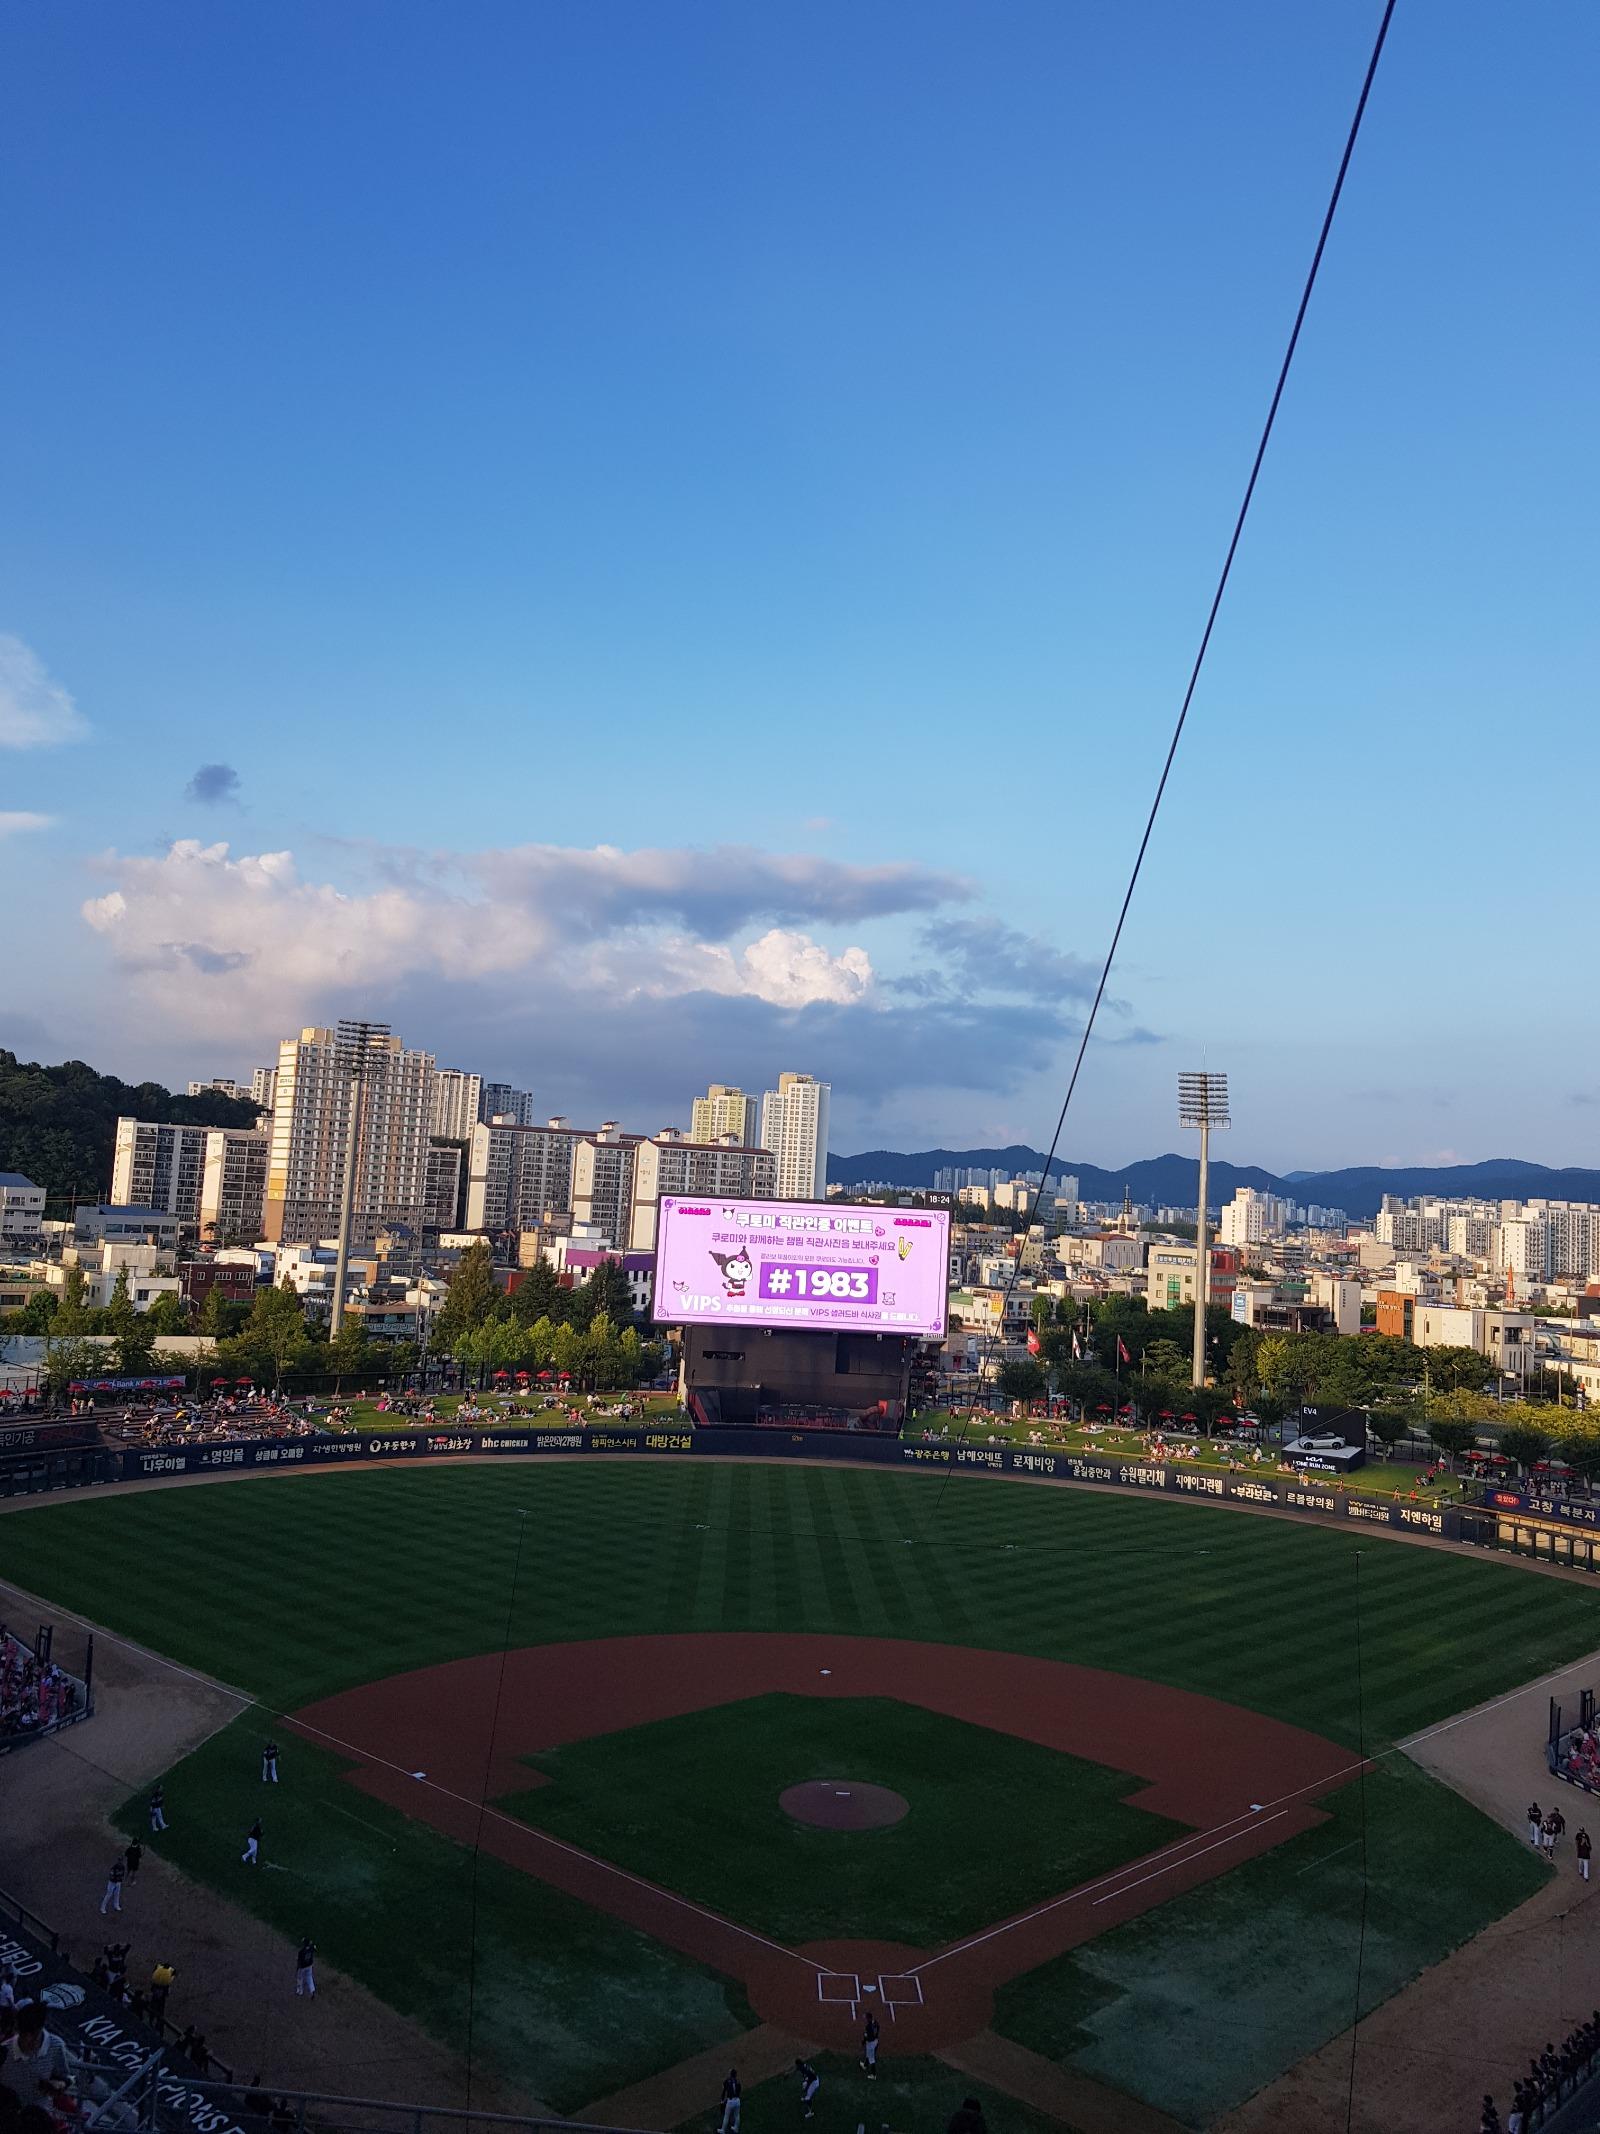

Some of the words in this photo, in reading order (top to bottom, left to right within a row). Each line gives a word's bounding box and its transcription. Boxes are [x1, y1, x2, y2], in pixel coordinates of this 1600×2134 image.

[929, 1195, 950, 1204] 18:24
[736, 1213, 776, 1229] 쿠로미
[779, 1215, 831, 1232] 직관인증
[834, 1218, 873, 1234] 이벤트
[712, 1233, 747, 1244] 쿠로미와
[749, 1235, 785, 1246] 함께하는
[787, 1237, 803, 1247] 챔필
[806, 1237, 850, 1249] 직관사진을
[852, 1240, 896, 1251] 보내주세요
[768, 1268, 869, 1298] #1983
[680, 1294, 722, 1312] VIPS
[810, 1309, 829, 1317] VIPS
[1303, 1407, 1317, 1416] EV4
[313, 1442, 362, 1455] 자생한방병원
[482, 1437, 499, 1448] bhc
[500, 1440, 528, 1448] CHICKEN
[536, 1435, 583, 1448] 밝은안과21병원
[645, 1434, 692, 1449] 대방건설
[914, 1449, 950, 1461] 광주은행
[956, 1449, 1004, 1463] 남해오네뜨
[1013, 1454, 1055, 1473] 로제비앙
[1321, 1463, 1336, 1471] ZONE
[1175, 1474, 1223, 1495] 지에이그린웰
[1236, 1486, 1272, 1501] 부라보콘
[1286, 1492, 1334, 1510] 르블랑의원
[1400, 1509, 1442, 1528] 지엔하임
[1528, 1499, 1554, 1513] 고창
[1560, 1504, 1596, 1522] 복분자
[0, 1940, 43, 1977] FIELD
[79, 2015, 124, 2046] KIA
